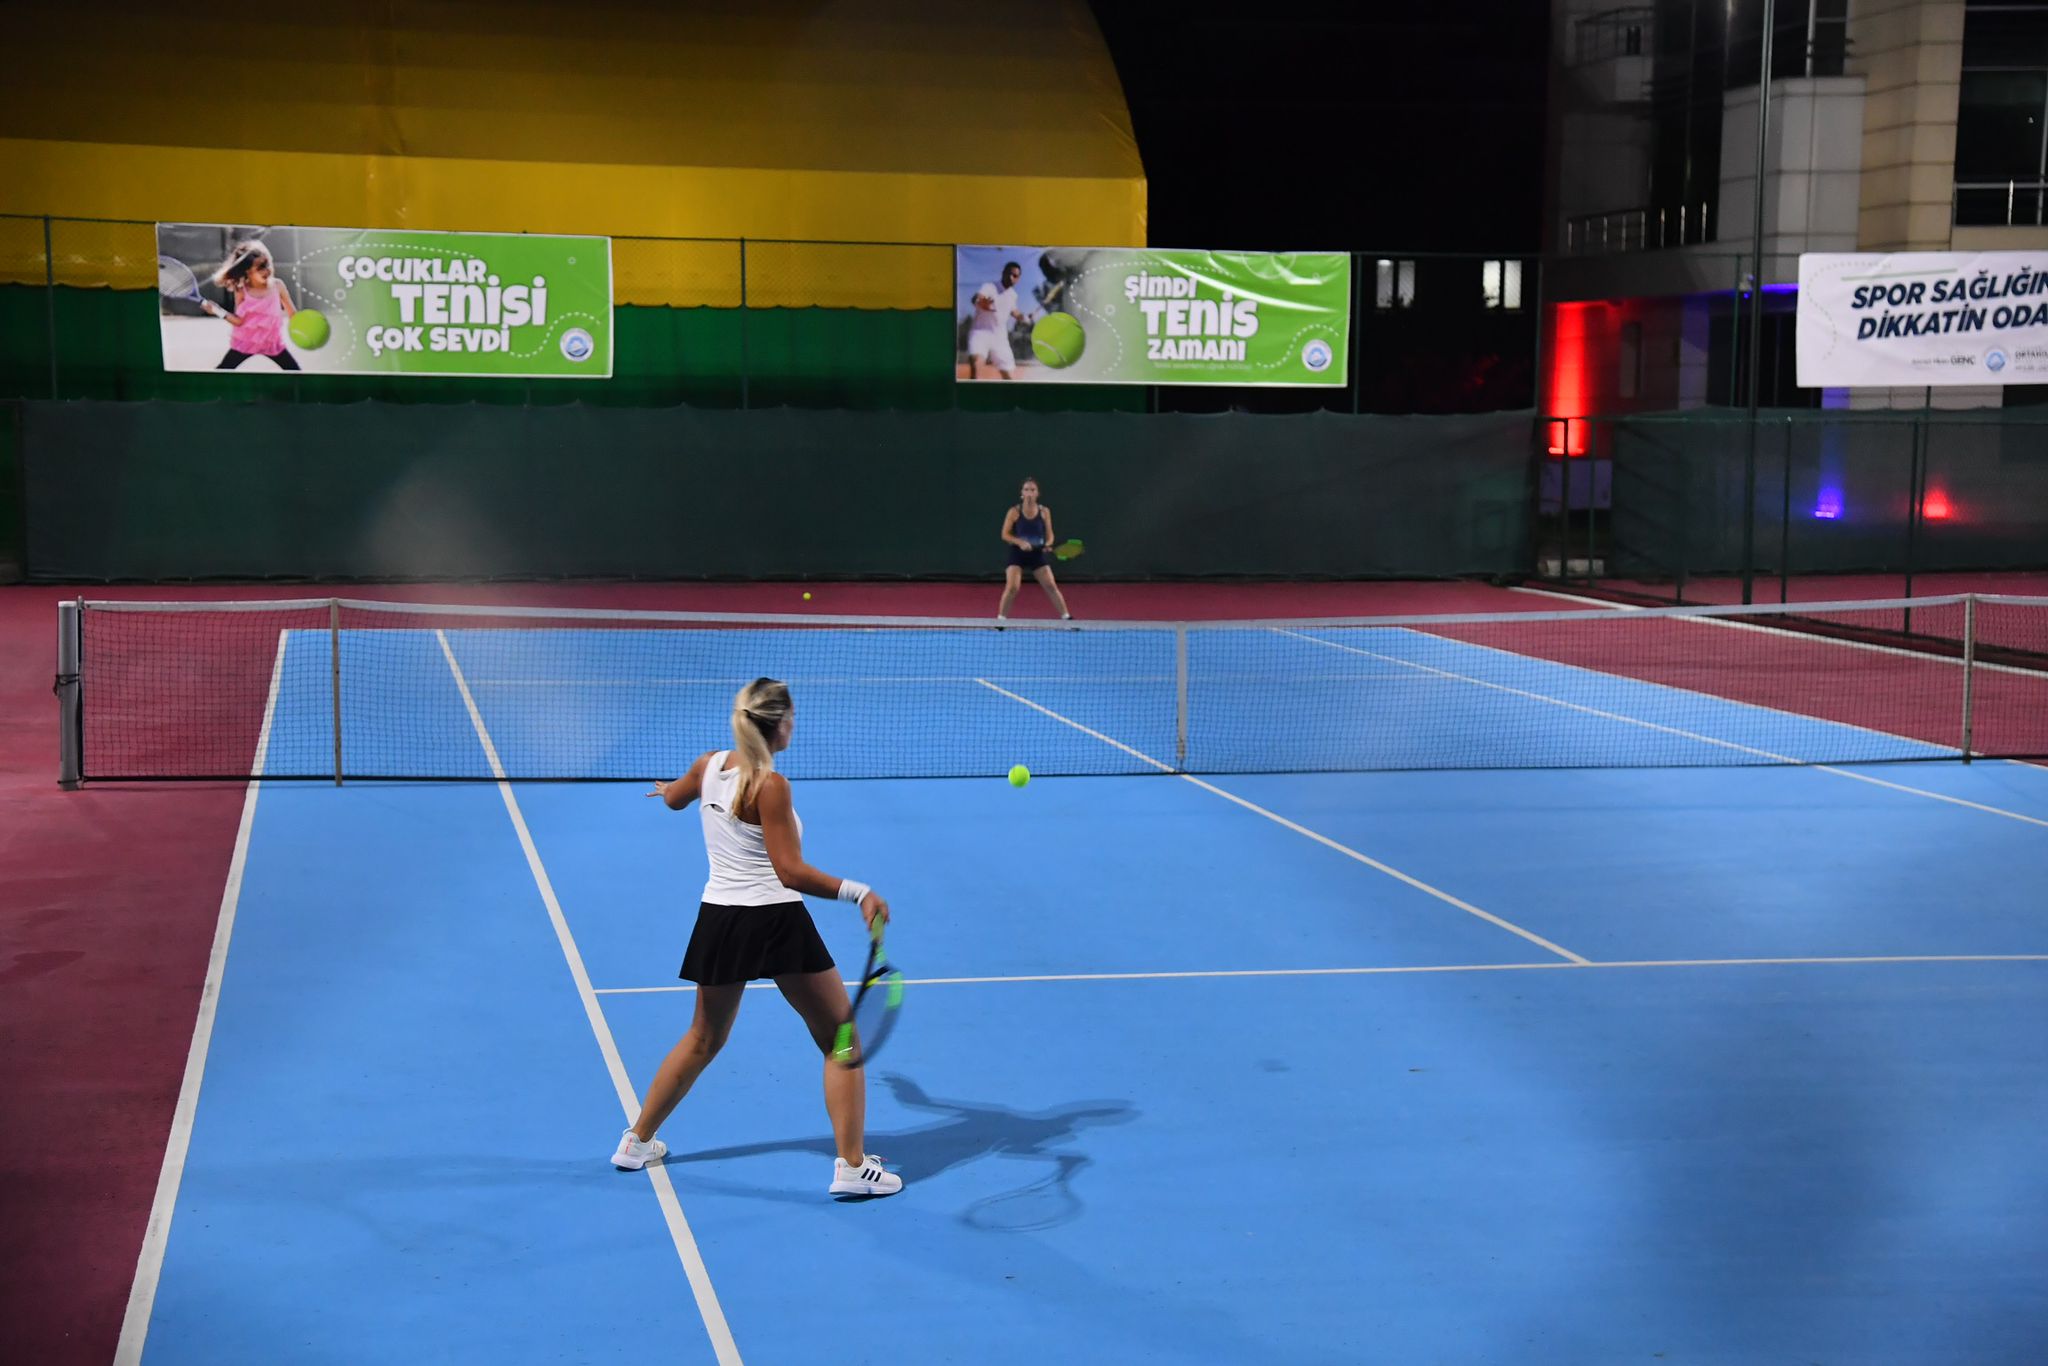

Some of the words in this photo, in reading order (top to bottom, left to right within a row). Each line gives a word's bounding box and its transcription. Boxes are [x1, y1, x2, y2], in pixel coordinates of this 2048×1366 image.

[337, 255, 487, 289] ÇOCUKLAR
[1124, 270, 1198, 304] ŞİMDİ
[391, 274, 548, 328] TENİSİ
[1851, 282, 1926, 309] SPOR
[1139, 291, 1260, 338] TENİS
[1857, 303, 1988, 340] DİKKATİN
[366, 325, 424, 358] ÇOK
[430, 323, 510, 353] SEVDİ
[1147, 338, 1246, 361] ZAMANI
